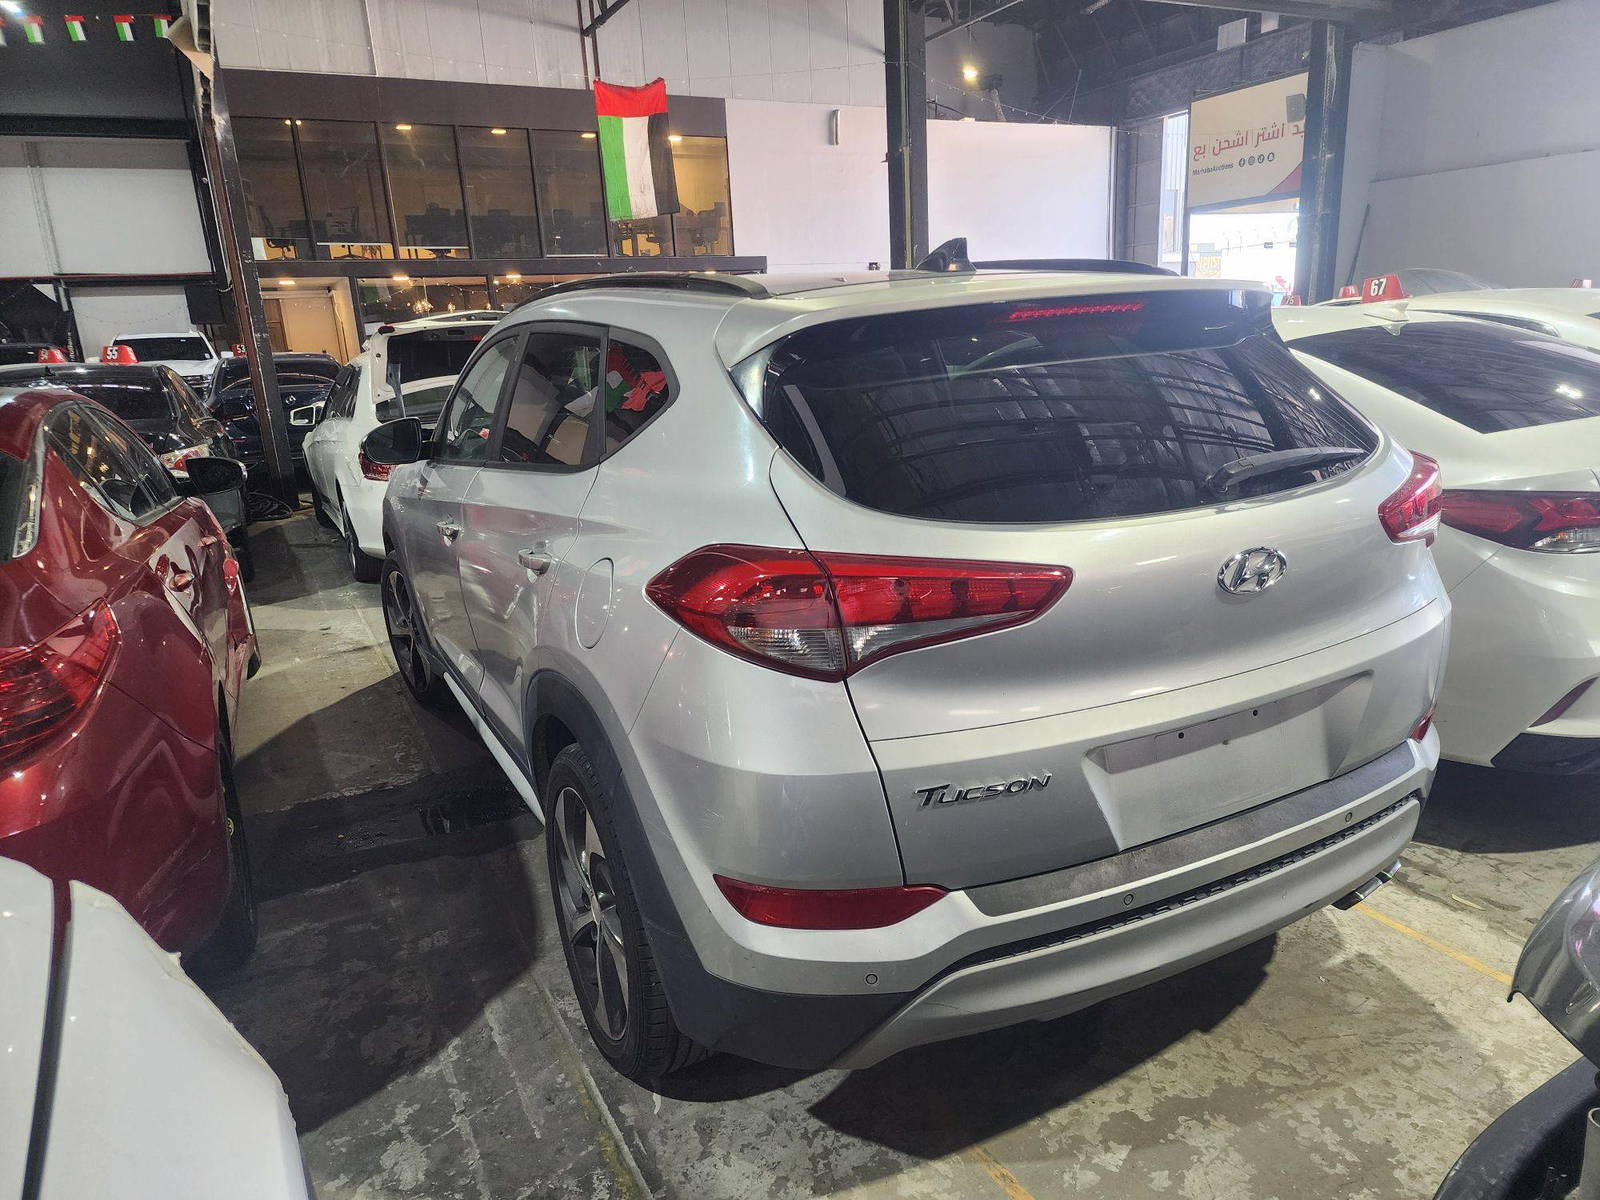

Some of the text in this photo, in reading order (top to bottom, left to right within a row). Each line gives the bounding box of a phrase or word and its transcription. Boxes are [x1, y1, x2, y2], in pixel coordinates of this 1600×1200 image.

[1212, 130, 1249, 156] اشحن
[1254, 122, 1285, 148] اشتر
[1193, 144, 1206, 162] بع
[1370, 277, 1387, 296] 67
[106, 346, 119, 360] 55
[236, 344, 246, 354] 53
[914, 772, 1052, 808] TUCSON
